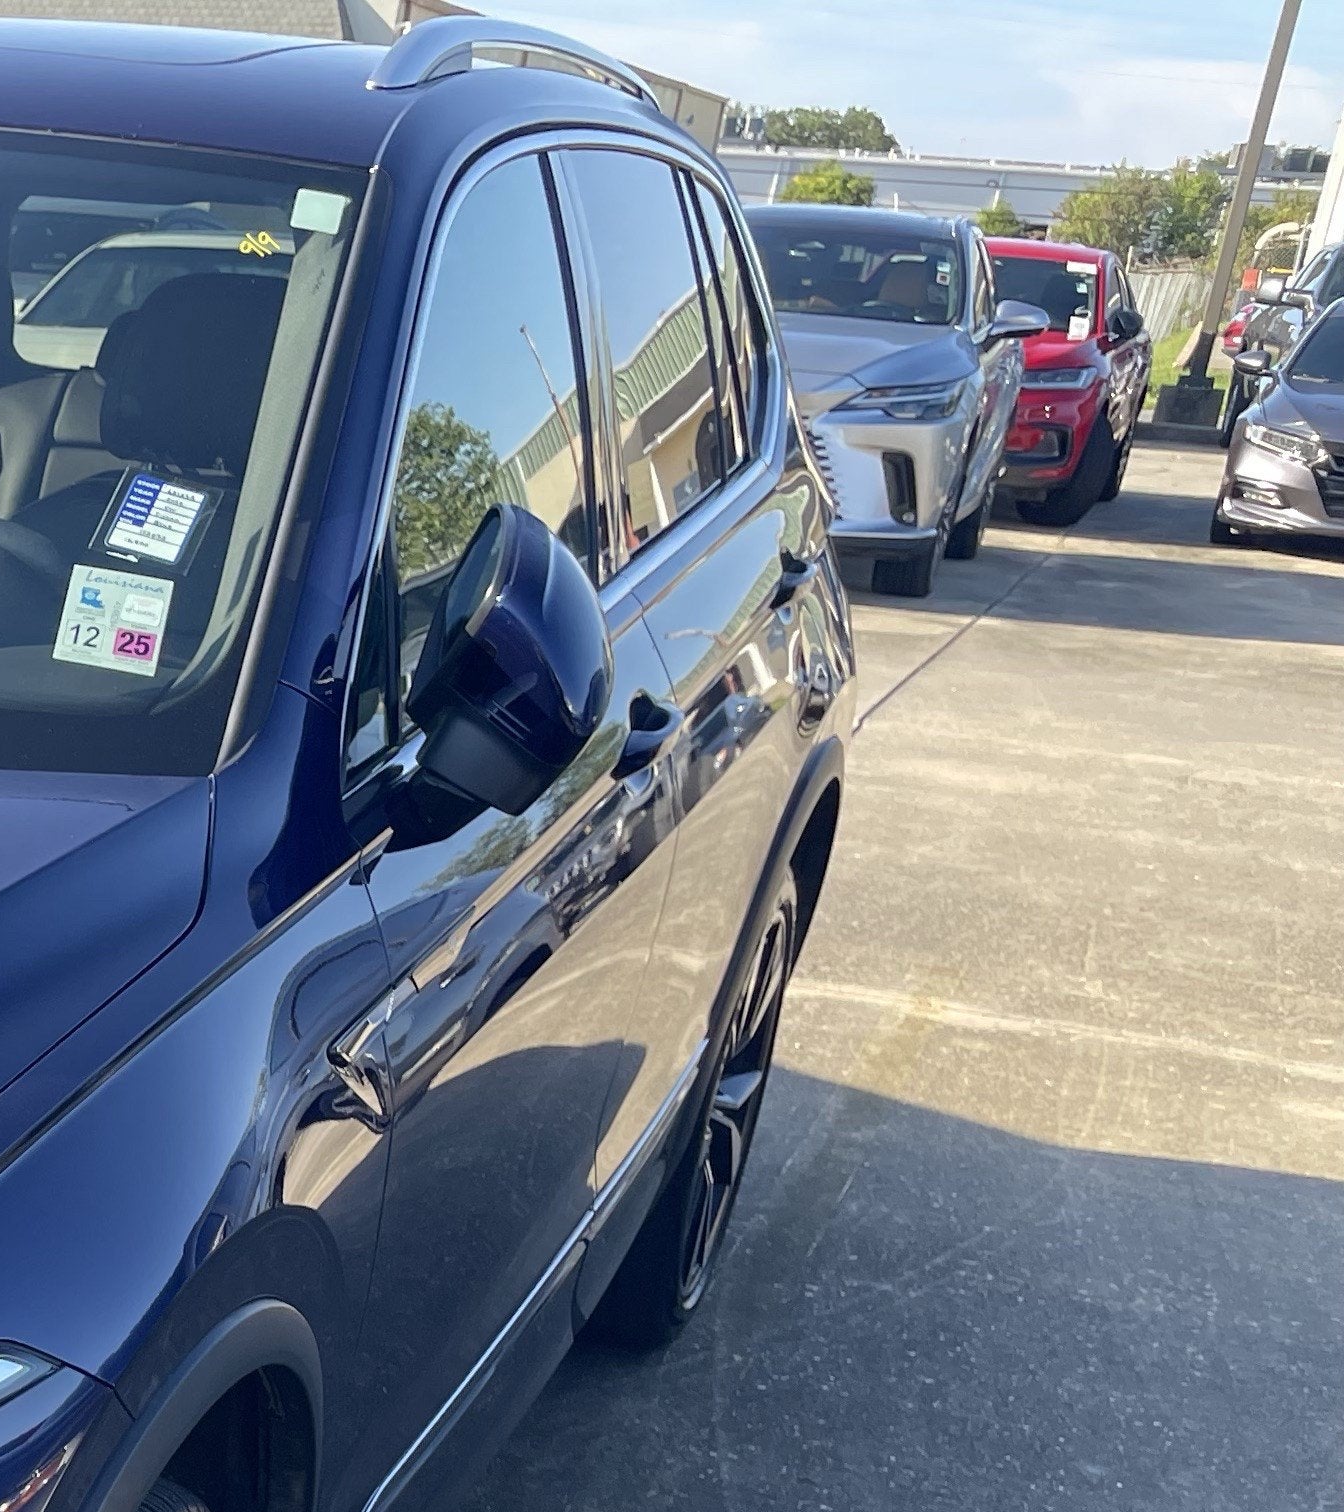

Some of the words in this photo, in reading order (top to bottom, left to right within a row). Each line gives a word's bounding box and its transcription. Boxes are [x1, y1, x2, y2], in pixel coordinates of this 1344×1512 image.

[85, 569, 164, 594] Louisiana
[70, 623, 101, 649] 12
[117, 631, 152, 656] 25
